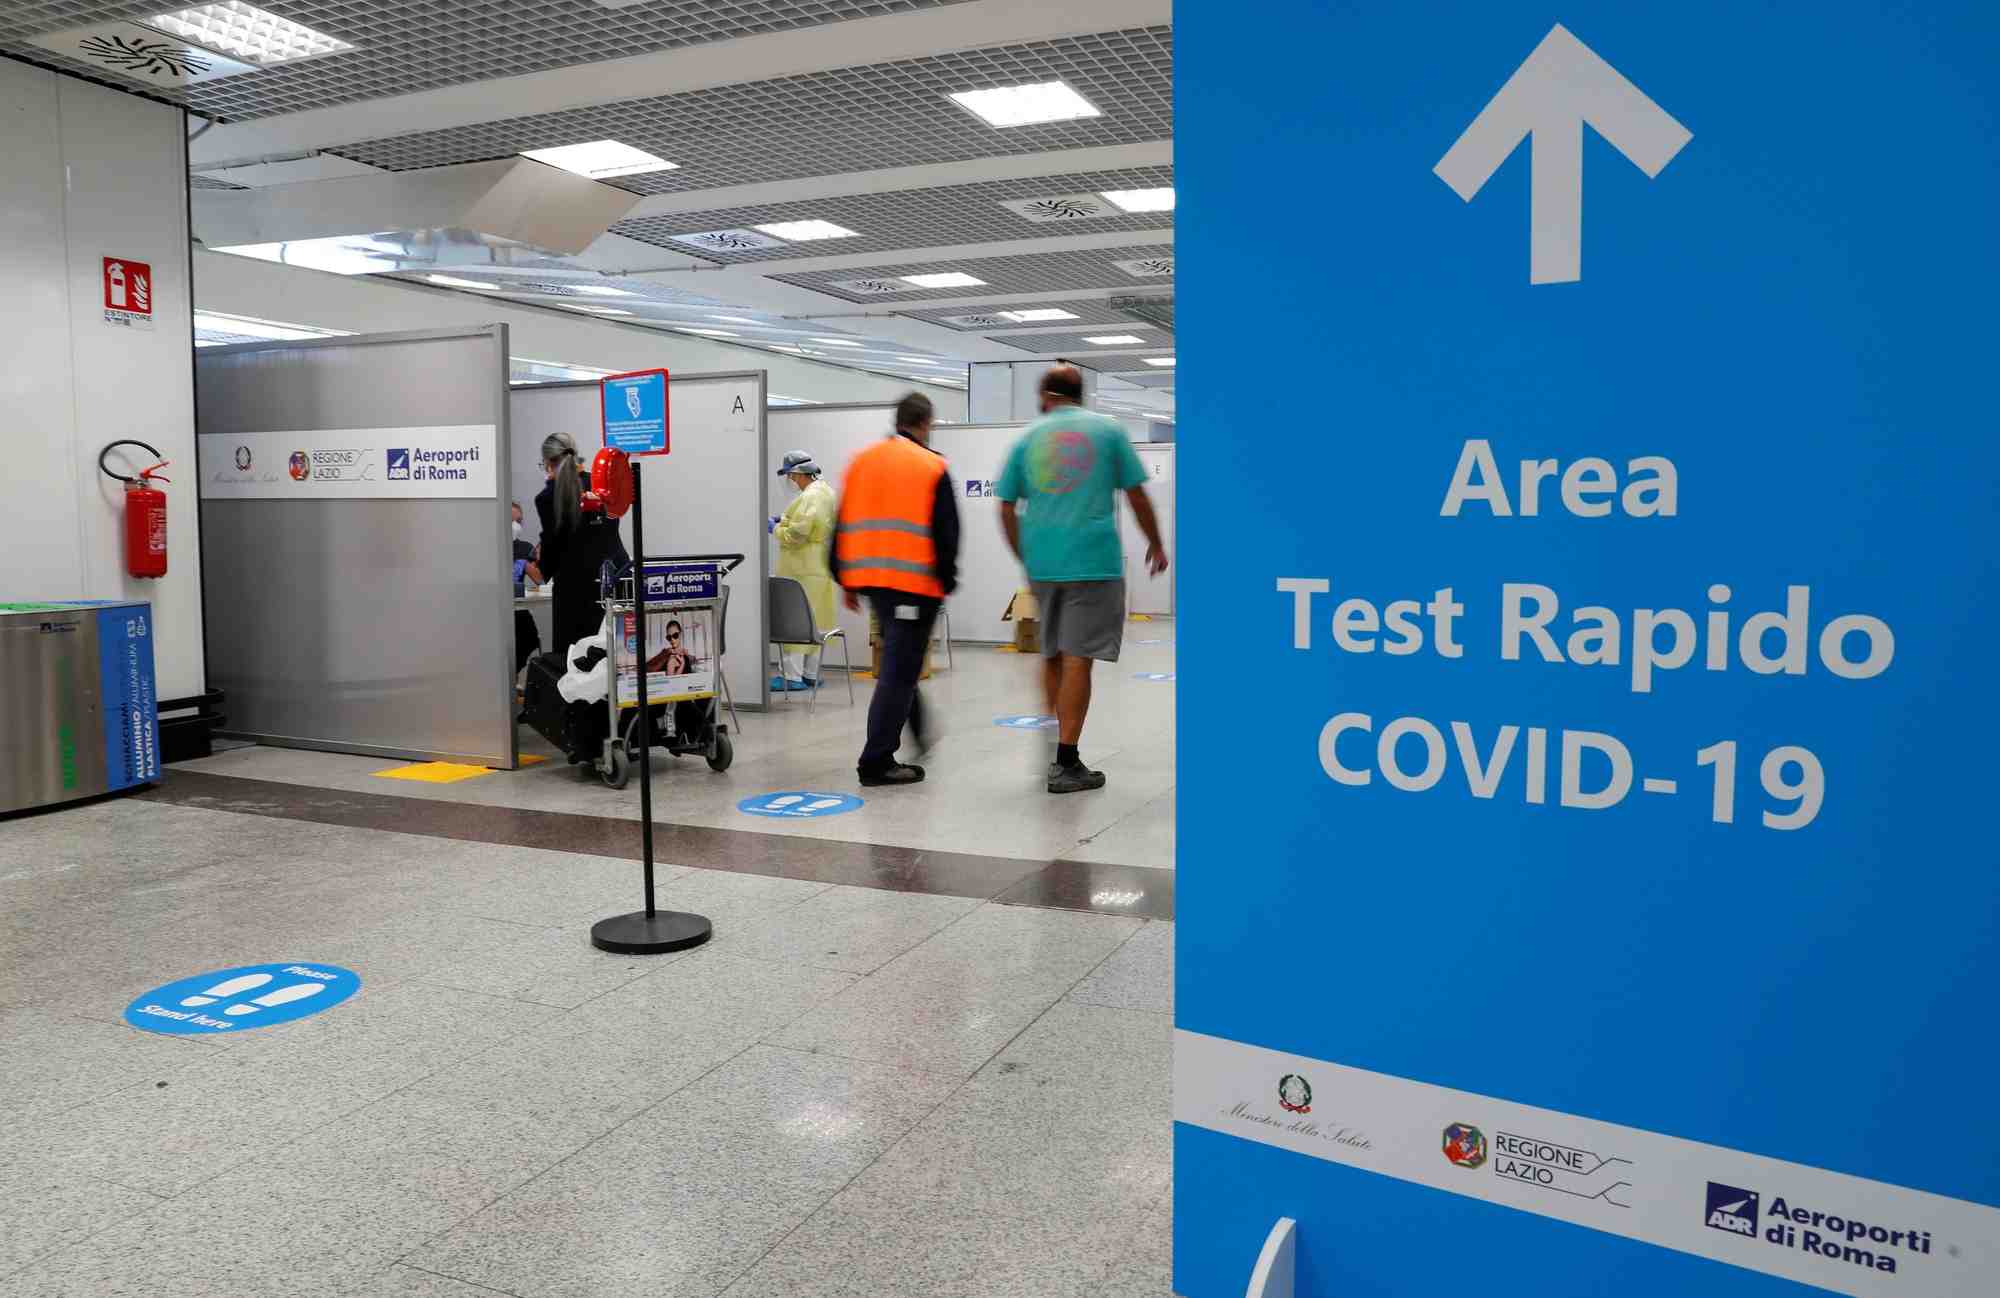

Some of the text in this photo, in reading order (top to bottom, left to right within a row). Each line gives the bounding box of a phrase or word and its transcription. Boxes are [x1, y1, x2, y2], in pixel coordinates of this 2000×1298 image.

[732, 395, 744, 414] A
[312, 451, 353, 465] REGIONE
[413, 446, 480, 465] Aeroporti
[312, 466, 341, 479] LAZIO
[413, 465, 467, 480] di Roma
[1439, 439, 1678, 518] Area
[666, 583, 676, 593] di
[677, 583, 703, 593] Roma
[1276, 577, 1895, 693] Test Rapido
[1318, 712, 1825, 830] COVID-19
[282, 966, 337, 981] Please
[136, 1004, 234, 1029] Stand here
[1287, 1119, 1319, 1137] della
[1321, 1124, 1373, 1151] Salute
[1496, 1135, 1584, 1169] REGIONE
[1495, 1157, 1554, 1184] LAZIO
[1708, 1211, 1754, 1236] ADR
[1768, 1197, 1932, 1255] Aeroporti
[1765, 1224, 1896, 1274] di Roma
